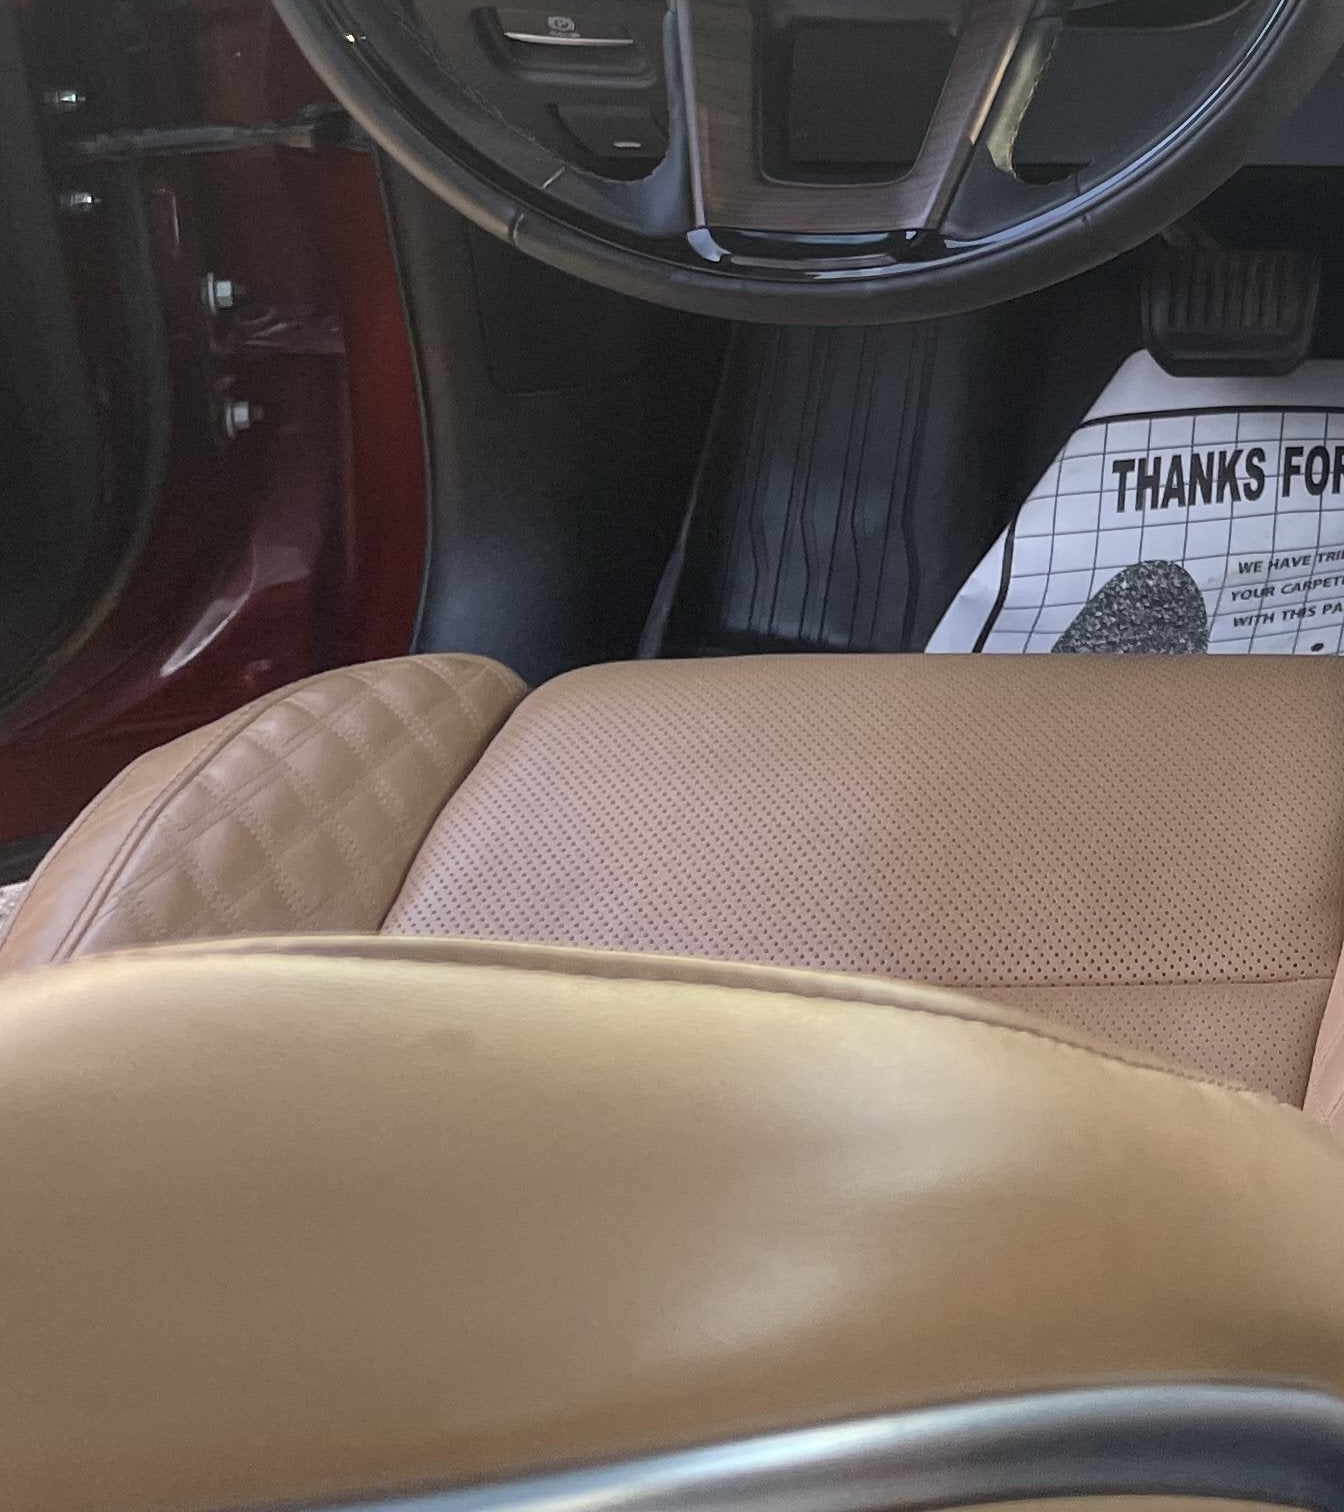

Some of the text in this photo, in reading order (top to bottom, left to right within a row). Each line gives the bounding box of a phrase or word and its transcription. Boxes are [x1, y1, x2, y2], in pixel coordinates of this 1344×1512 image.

[1112, 446, 1266, 513] THANKS
[1238, 560, 1263, 574] WE
[1268, 555, 1311, 571] HAVE
[1231, 586, 1275, 601] YOUR
[1233, 612, 1274, 627] WITH
[1282, 606, 1316, 621] THIS
